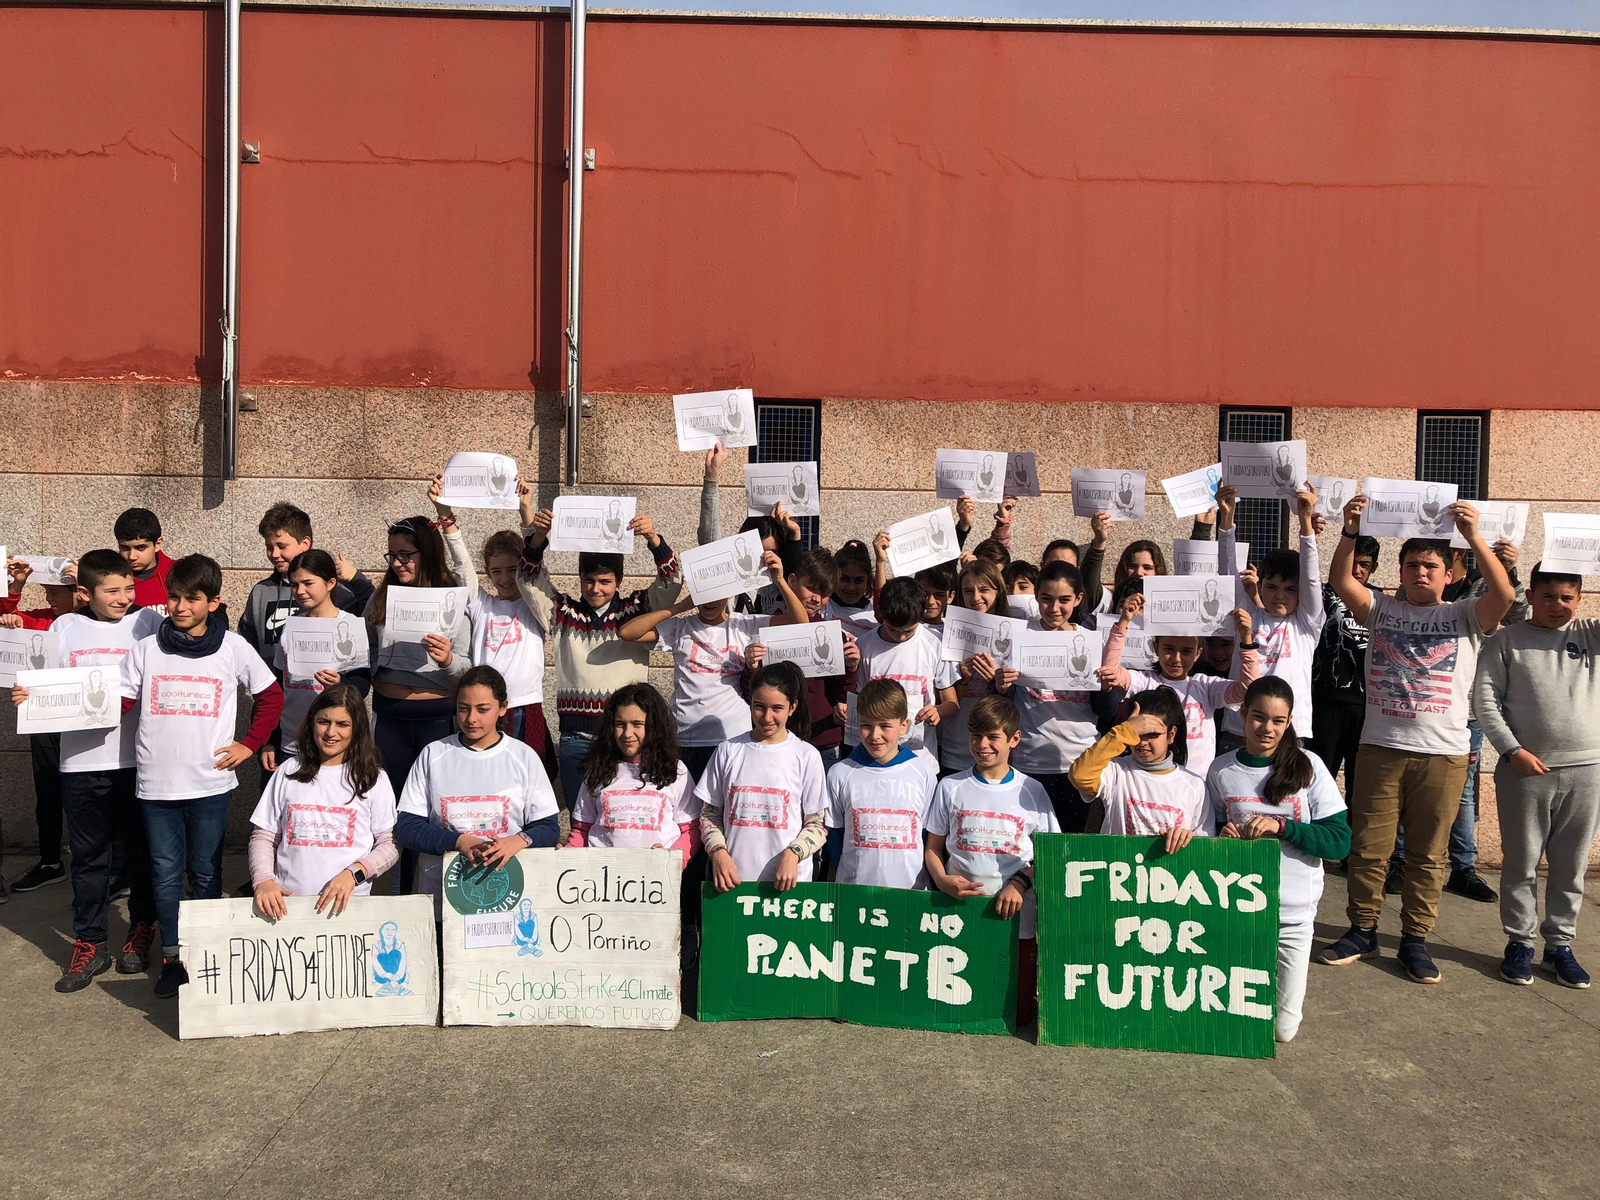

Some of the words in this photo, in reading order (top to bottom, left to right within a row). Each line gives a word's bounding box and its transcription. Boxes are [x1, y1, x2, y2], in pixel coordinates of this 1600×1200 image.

[1378, 612, 1409, 629] WEST
[1412, 620, 1458, 633] COAST
[161, 690, 211, 700] cooltureco
[1390, 701, 1410, 710] TO
[1414, 703, 1448, 715] LAST
[449, 811, 500, 820] cooltureco
[611, 803, 658, 813] cooltureco
[294, 819, 344, 830] cooltureco
[861, 822, 909, 832] cooltureco
[965, 825, 1013, 837] cooltureco
[447, 854, 468, 888] FRIDA
[556, 866, 667, 905] Galicia
[736, 895, 835, 923] THERE
[859, 907, 889, 927] IS
[920, 912, 965, 939] NO
[549, 915, 572, 952] O
[582, 913, 651, 951] Porriño
[1114, 915, 1207, 955] FOR
[1064, 963, 1273, 1020] FUTURE
[519, 1004, 605, 1022] QUEREMOS
[612, 1006, 674, 1022] FUTURO
